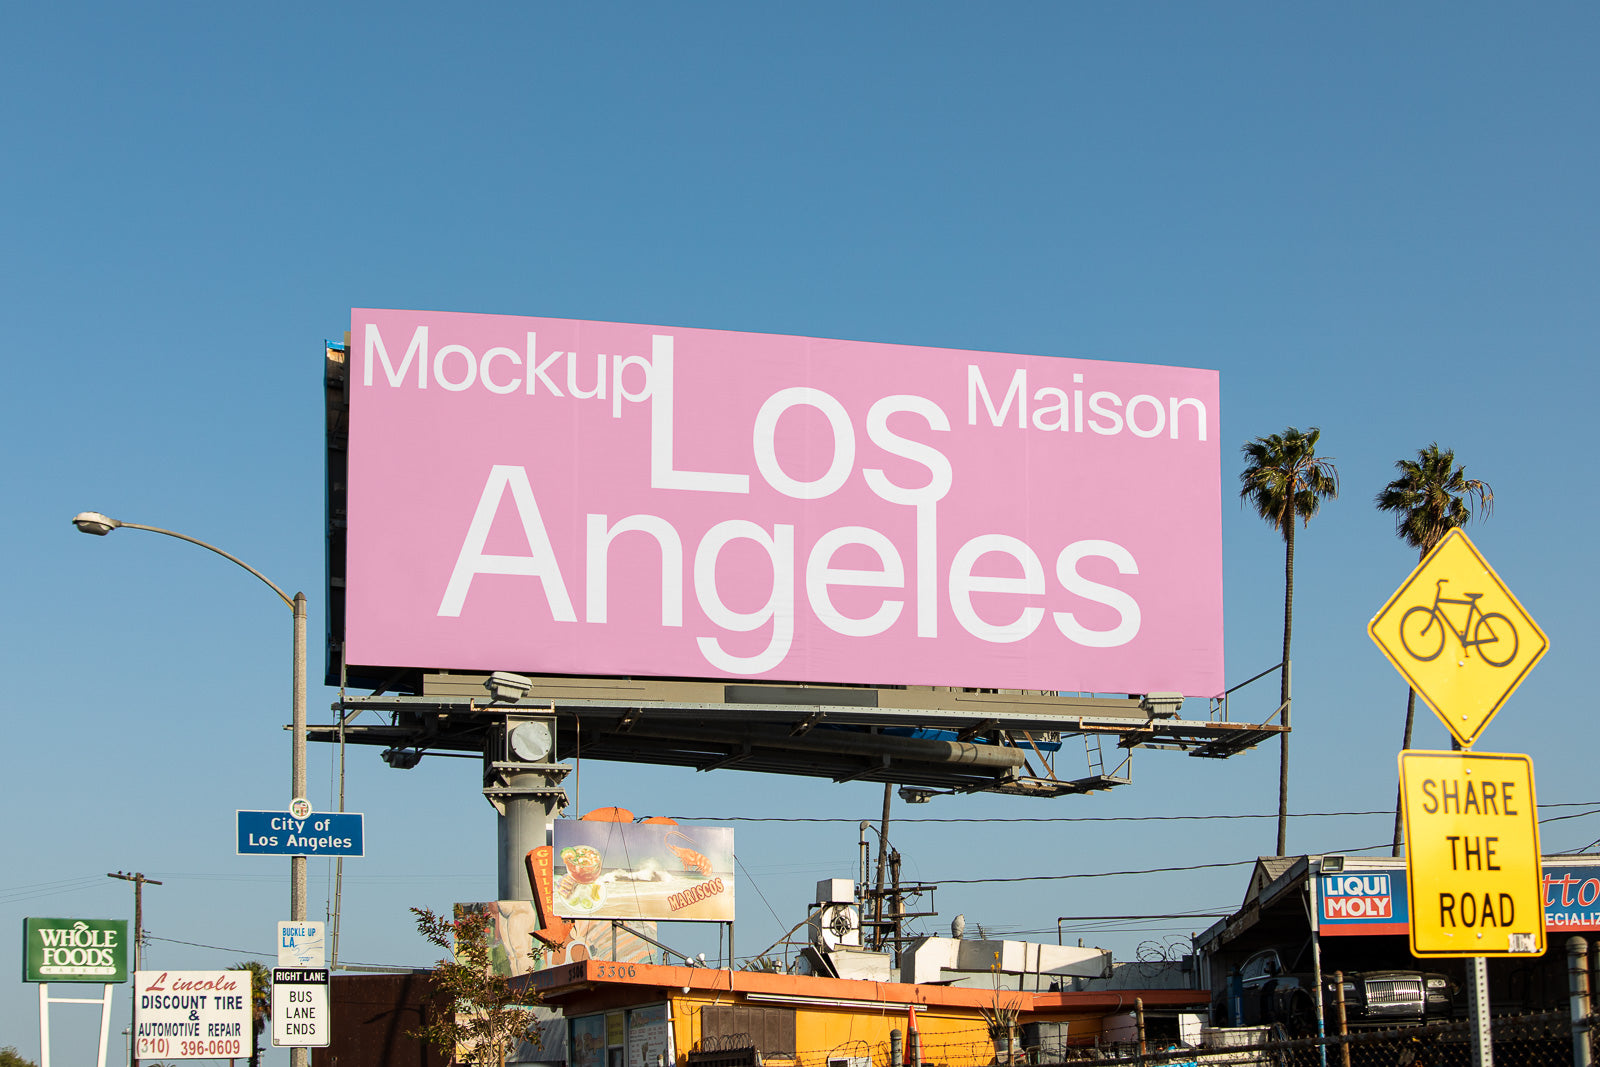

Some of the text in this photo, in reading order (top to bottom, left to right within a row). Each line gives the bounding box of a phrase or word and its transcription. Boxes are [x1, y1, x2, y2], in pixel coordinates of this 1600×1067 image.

[363, 323, 653, 418] Mockup
[967, 365, 1207, 441] Maison
[651, 334, 952, 505] Los
[436, 465, 1142, 674] Angeles
[1422, 778, 1518, 815] SHARE
[271, 817, 331, 833] City of
[248, 833, 352, 851] Los Angeles
[1446, 836, 1501, 871] THE
[536, 849, 553, 913] GUILLEN
[1326, 876, 1387, 896] LIQUI
[667, 877, 724, 911] MARISCOS
[1327, 897, 1390, 917] MOLY
[1440, 893, 1515, 928] ROAD
[38, 922, 118, 947] WHOLE
[282, 927, 316, 936] BUCKLE UP
[282, 937, 295, 948] LA
[42, 947, 114, 966] FOODS
[276, 971, 326, 981] RIGHT LANE
[597, 965, 636, 979] 3306
[145, 972, 237, 992] Lincoln
[141, 995, 243, 1010] DISCOUNT TIRE
[289, 991, 313, 1003] BUS
[188, 1010, 200, 1021] &
[286, 1007, 316, 1018] LANE
[138, 1023, 241, 1037] AUTOMOTIVE REPAIR
[286, 1023, 316, 1035] ENDS
[136, 1038, 240, 1057] (310) 396-0609
